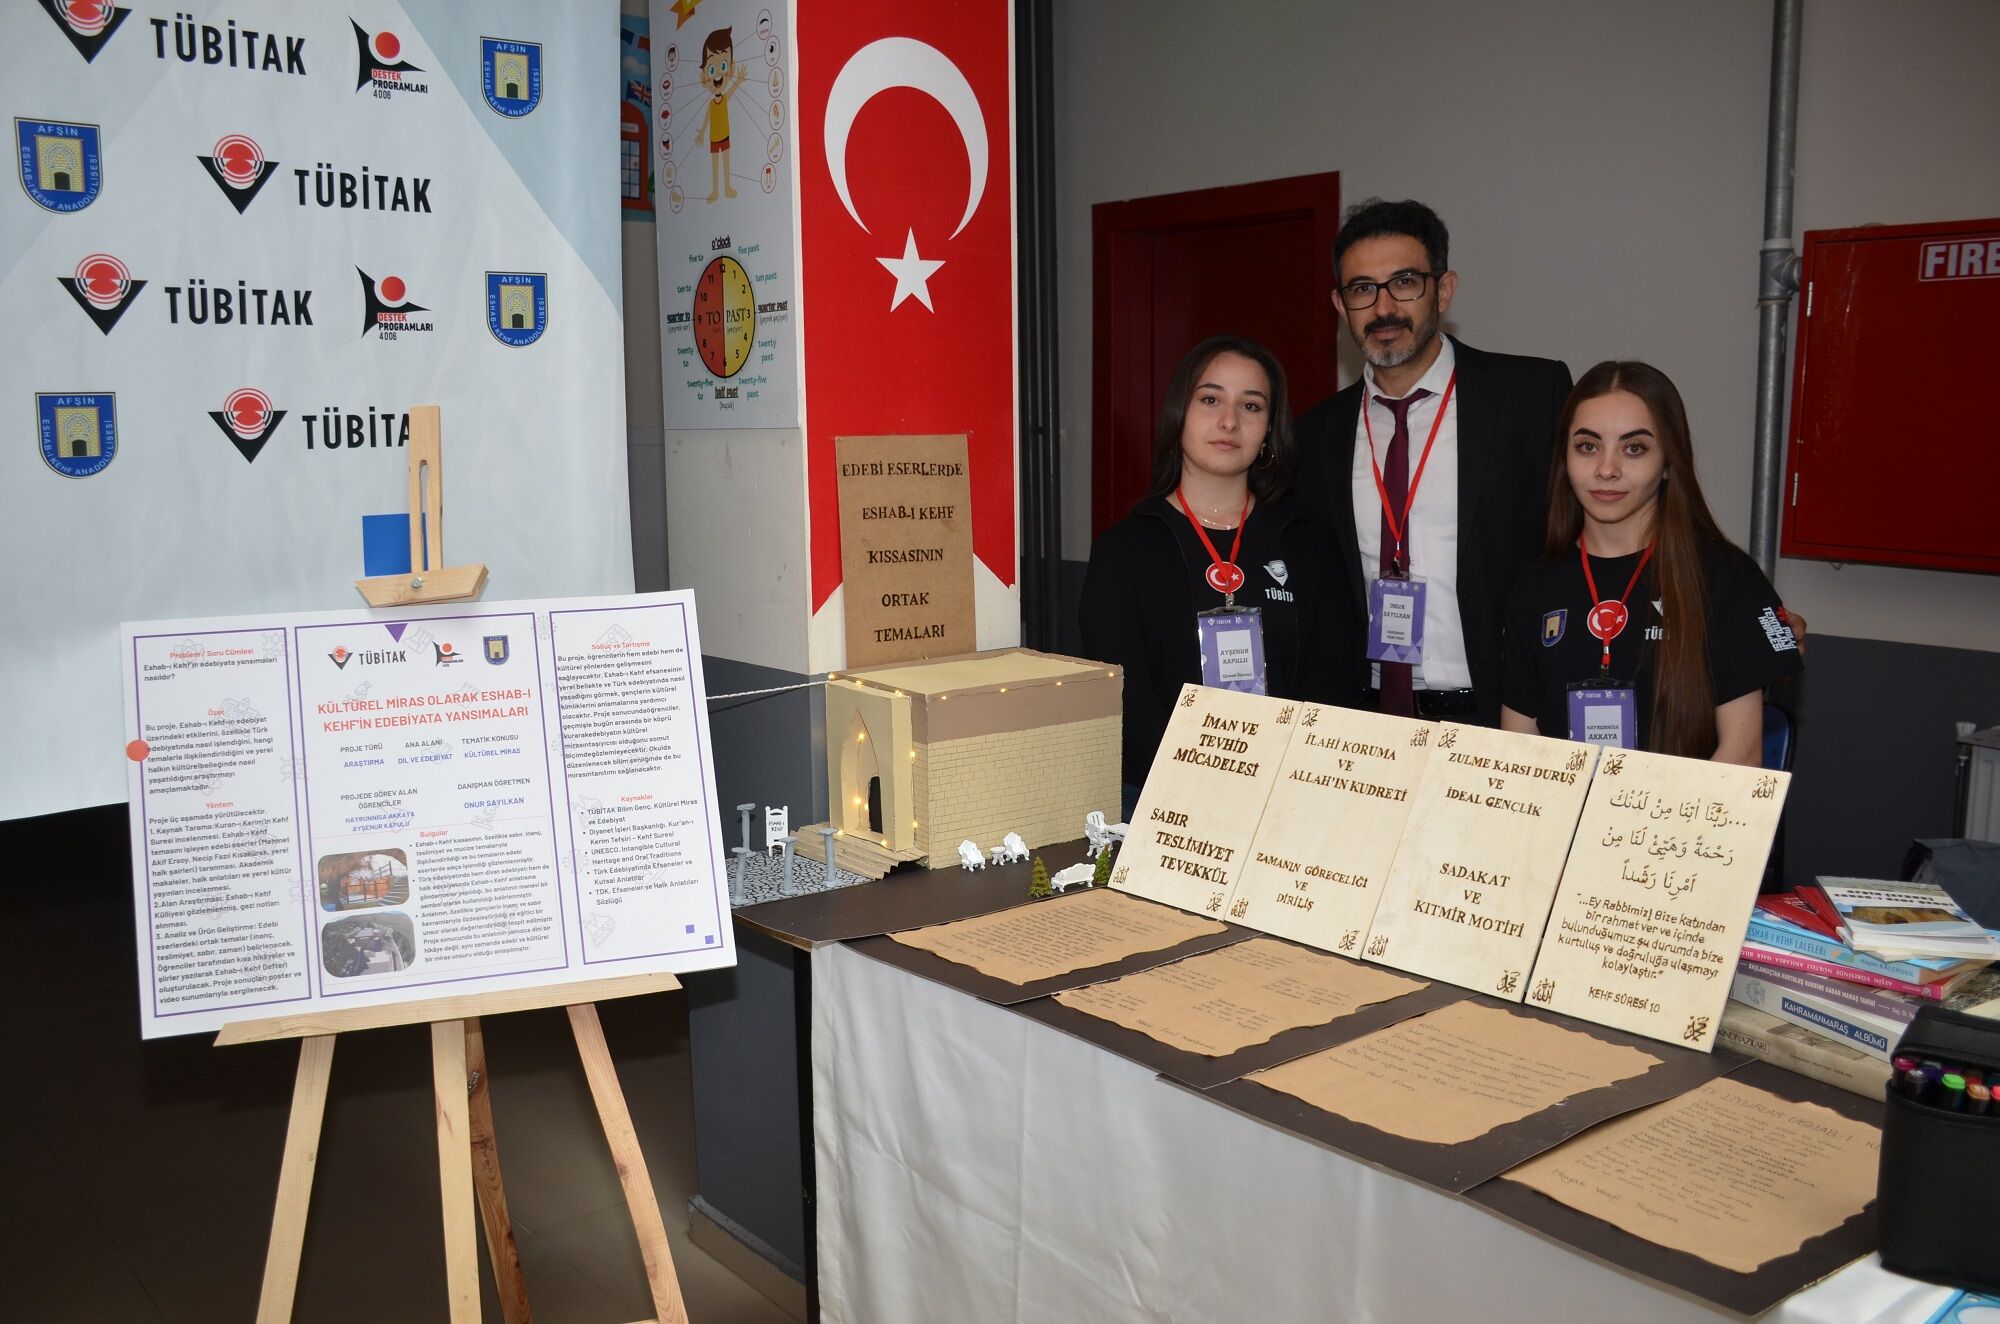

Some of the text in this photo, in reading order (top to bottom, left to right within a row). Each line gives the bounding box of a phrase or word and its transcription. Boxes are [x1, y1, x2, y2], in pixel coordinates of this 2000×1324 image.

[150, 15, 307, 76] TÜBİTAK
[373, 69, 402, 81] DESTEK
[373, 80, 428, 94] PROGRAMLARI
[373, 89, 392, 100] 4006
[38, 125, 79, 136] AFŞİN
[294, 163, 432, 214] TÜBİTAK
[57, 189, 97, 211] ANADOLU
[1924, 241, 2000, 278] FIRE
[742, 285, 746, 294] 2
[164, 279, 313, 326] TÜBİTAK
[378, 313, 407, 322] DESTEK
[706, 311, 721, 325] TO
[726, 309, 746, 323] PAST
[747, 310, 751, 319] 3
[379, 322, 433, 331] PROGRAMLARI
[379, 332, 397, 341] 4006
[743, 332, 748, 341] 4
[735, 349, 740, 359] 5
[57, 397, 95, 406] AFŞİN
[75, 451, 113, 475] ANADOLU
[842, 461, 964, 477] EDEBİ ESERLERDE
[919, 505, 955, 520] KEHF
[867, 548, 944, 564] KISSASININ
[881, 592, 930, 607] ORTAK
[874, 624, 945, 643] TEMALARI
[359, 649, 407, 665] TÜBİTAK
[317, 688, 532, 715] KÜLTÜREL MİRAS OLARAK ESHAB-I
[323, 706, 529, 733] KEHF'İN EDEBİYATA YANSIMALARI
[1202, 712, 1259, 736] İMAN VE
[421, 739, 443, 747] ALANI
[461, 734, 519, 745] TEMATİK KONUSU
[1199, 734, 1249, 754] TEVHİD
[1304, 732, 1396, 761] İLAHİ KORUMA
[340, 743, 383, 753] PROJE TÜRÜ
[464, 750, 499, 759] KÜLTÜREL
[344, 758, 385, 768] ARAŞTIRMA
[397, 757, 409, 765] DİL
[420, 754, 453, 763] EDEBİYAT
[1173, 748, 1260, 777] MÜCADELESİ
[1338, 758, 1355, 772] VE
[1448, 752, 1490, 769] ZULME
[1533, 768, 1577, 786] DURUŞ
[457, 777, 531, 791] DANIŞMAN ÖĞRETMEN
[1289, 769, 1408, 802] ALLAH'IN KUDRETİ
[1488, 777, 1505, 790] VE
[464, 797, 525, 809] ONUR SAYILKAN
[1445, 786, 1543, 817] İDEAL GENÇLİK
[1150, 807, 1189, 828] SABIR
[1156, 831, 1235, 863] TESLİMİYET
[1160, 855, 1229, 886] TEVEKKÜL
[1256, 852, 1369, 889] ZAMANIN GÖRECELİĞİ
[1439, 863, 1511, 888] SADAKAT
[1295, 880, 1309, 891] VE
[1276, 893, 1315, 912] DİRİLİŞ
[1463, 889, 1482, 905] VE
[1413, 900, 1525, 938] KITMİR MOTİFİ
[1602, 899, 1653, 922] Rabbimiz!
[1654, 910, 1678, 924] Bize
[1679, 914, 1726, 934] katından
[1585, 909, 1705, 944] bir rahmet ver ve içinde
[1561, 917, 1724, 964] bulunduğumuz şu durumda bize
[1775, 934, 1793, 948] KEHF
[1558, 933, 1719, 980] kurtuluş ve doğruluğa ulaşmayı
[1756, 952, 1772, 961] HALK
[1835, 969, 1871, 982] YÖRESİNDE
[1879, 963, 1914, 978] KALENDER
[1782, 973, 1804, 986] KURTULUŞ
[1825, 987, 1841, 996] KADAR
[1842, 991, 1859, 1003] MARAŞ
[1873, 976, 1893, 987] AFŞİN
[1588, 986, 1614, 1001] KEHF
[1649, 1002, 1661, 1013] 10
[1783, 1001, 1886, 1049] KAHRAMANMARAŞ ALBÜMÜ
